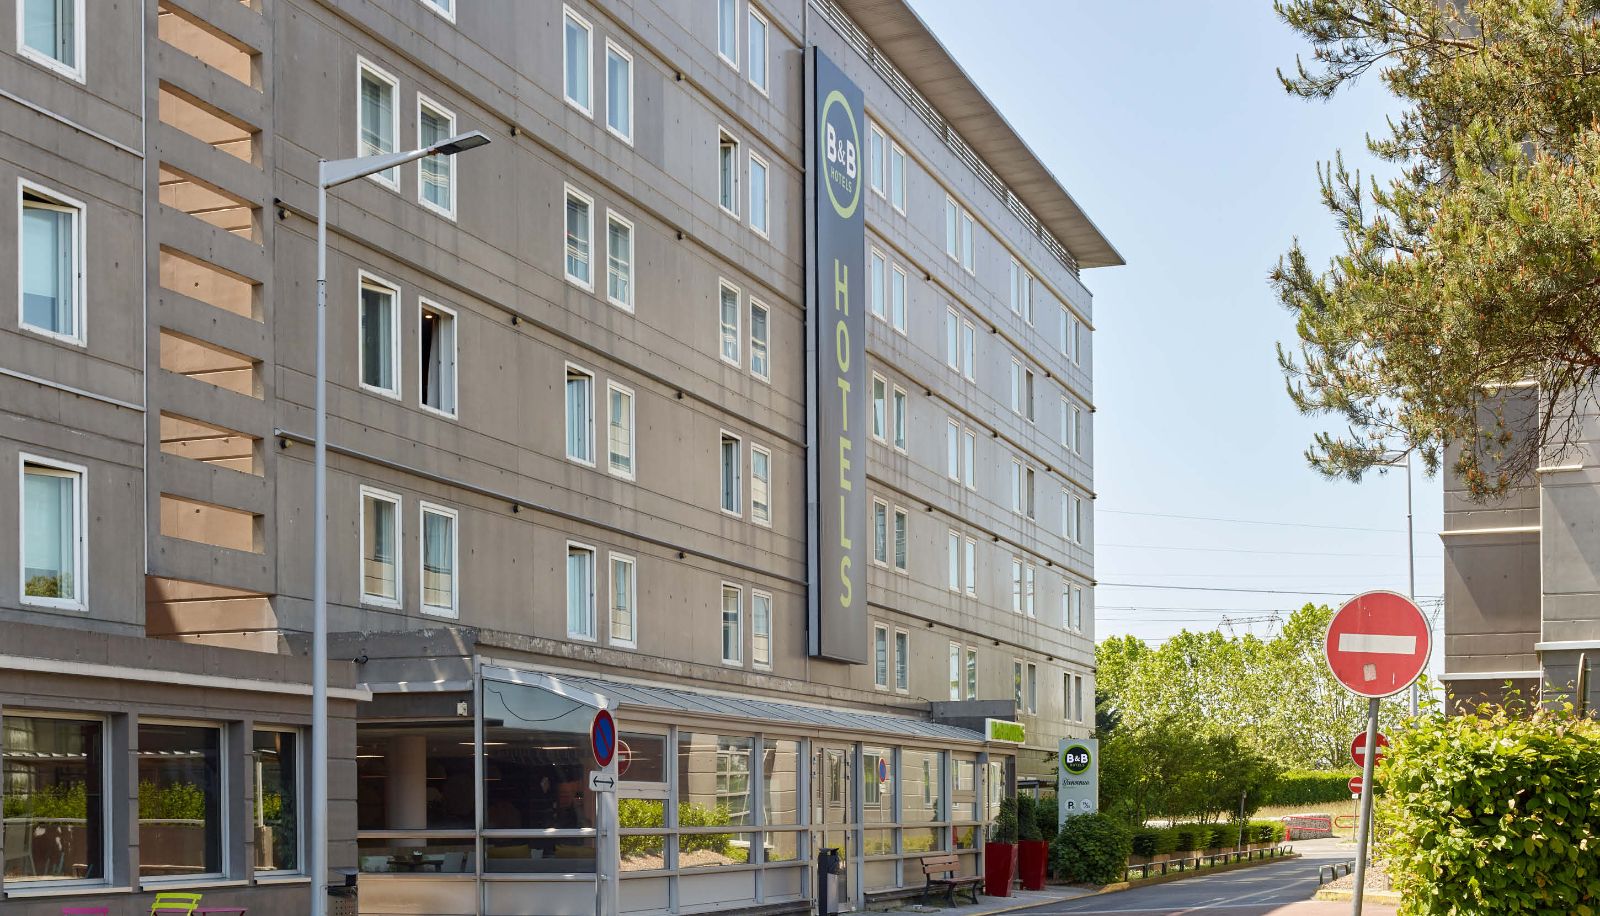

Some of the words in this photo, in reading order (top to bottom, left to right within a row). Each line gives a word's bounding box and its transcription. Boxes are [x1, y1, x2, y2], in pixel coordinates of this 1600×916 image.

[827, 122, 857, 179] B&B
[831, 167, 852, 193] HOTELS
[834, 258, 852, 608] HOTELS
[1066, 753, 1088, 764] B&B
